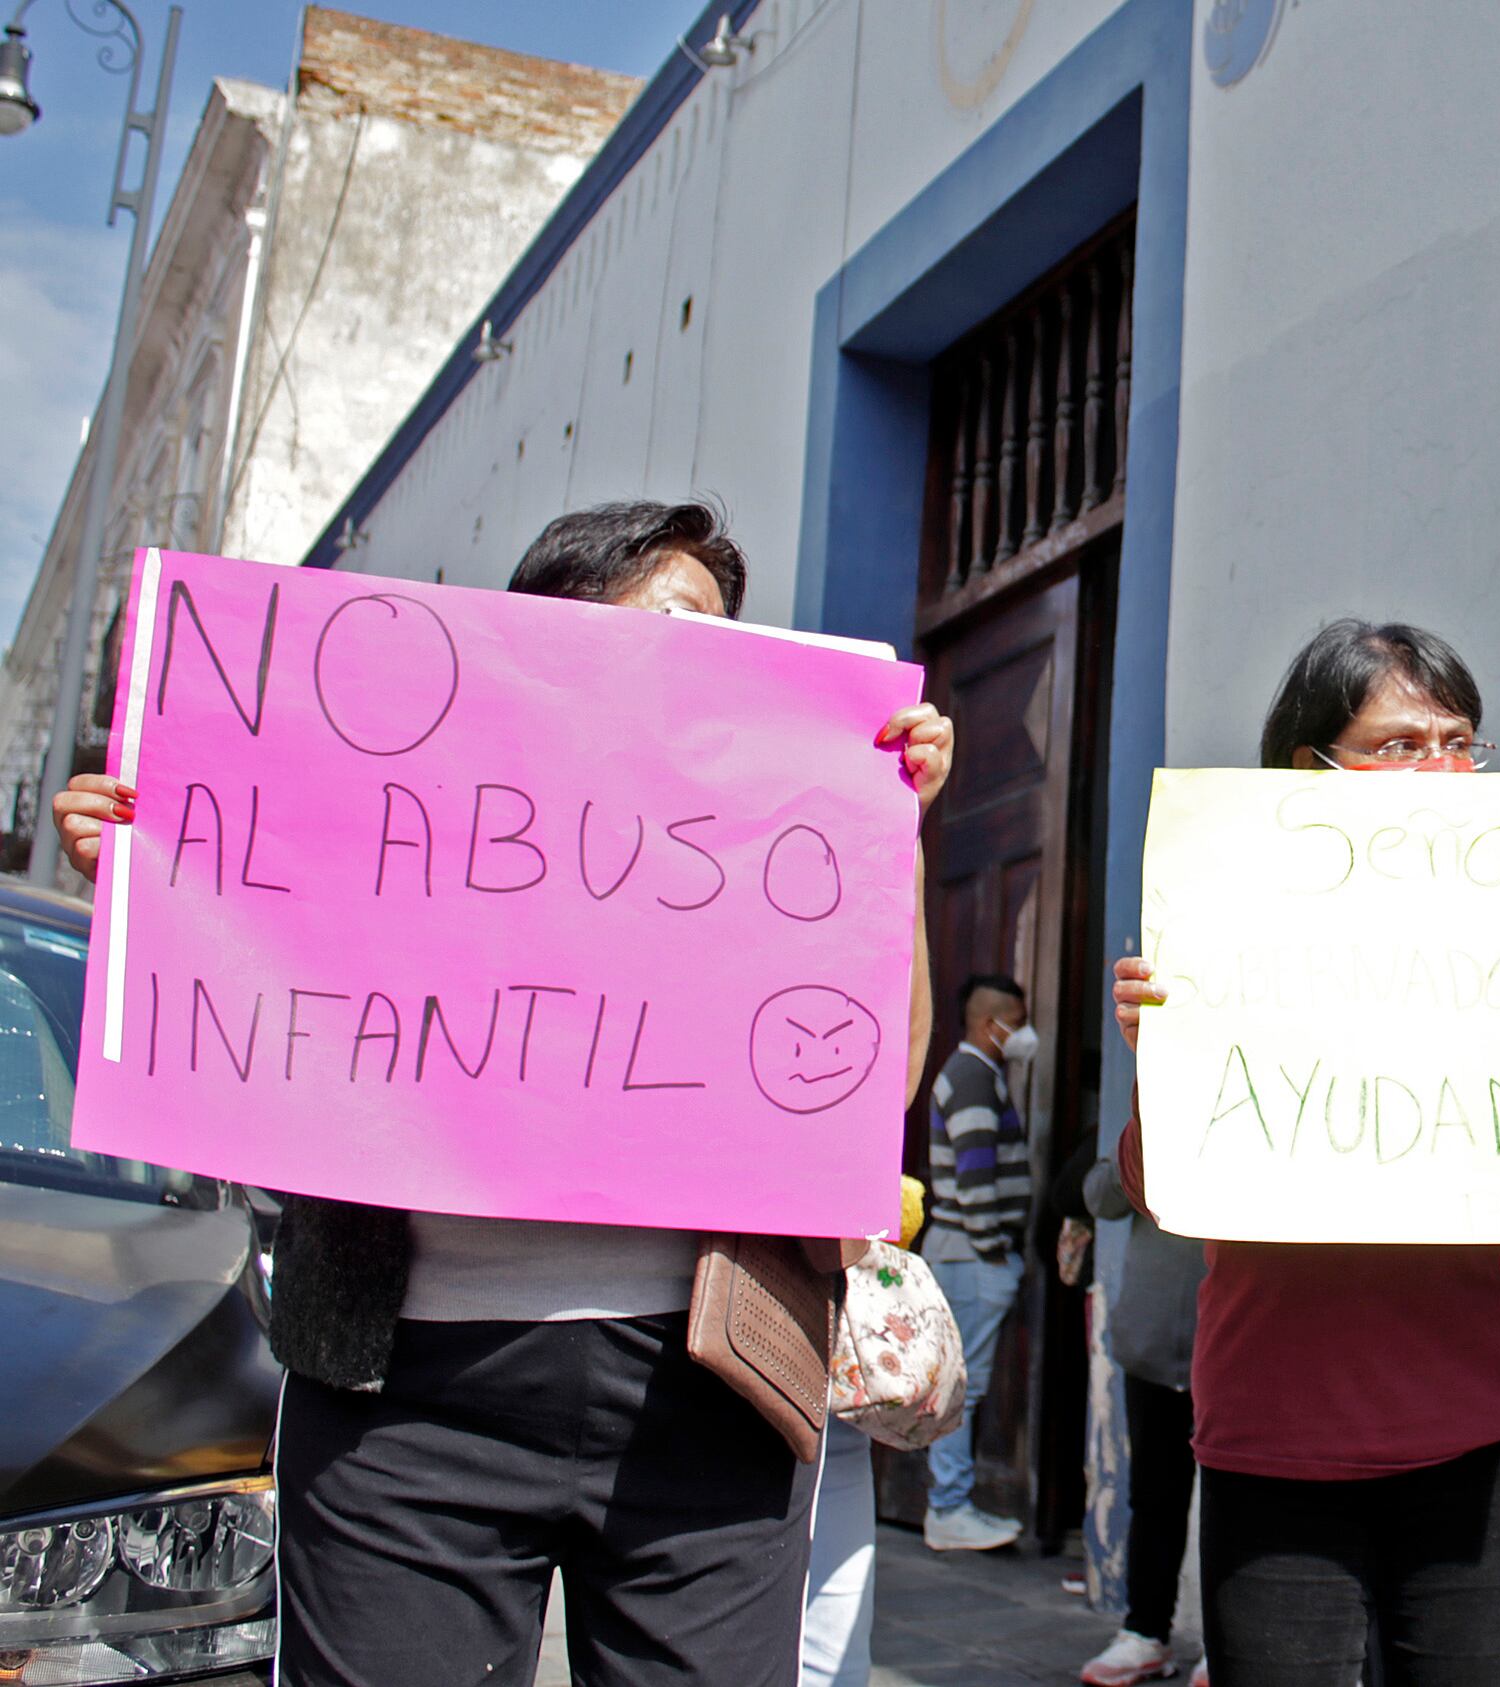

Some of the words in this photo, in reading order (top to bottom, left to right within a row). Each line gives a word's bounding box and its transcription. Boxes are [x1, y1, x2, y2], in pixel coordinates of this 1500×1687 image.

[156, 580, 459, 756] NO
[169, 783, 291, 896] AL
[375, 783, 843, 922] ABUSO
[147, 972, 706, 1091] INFANTIL
